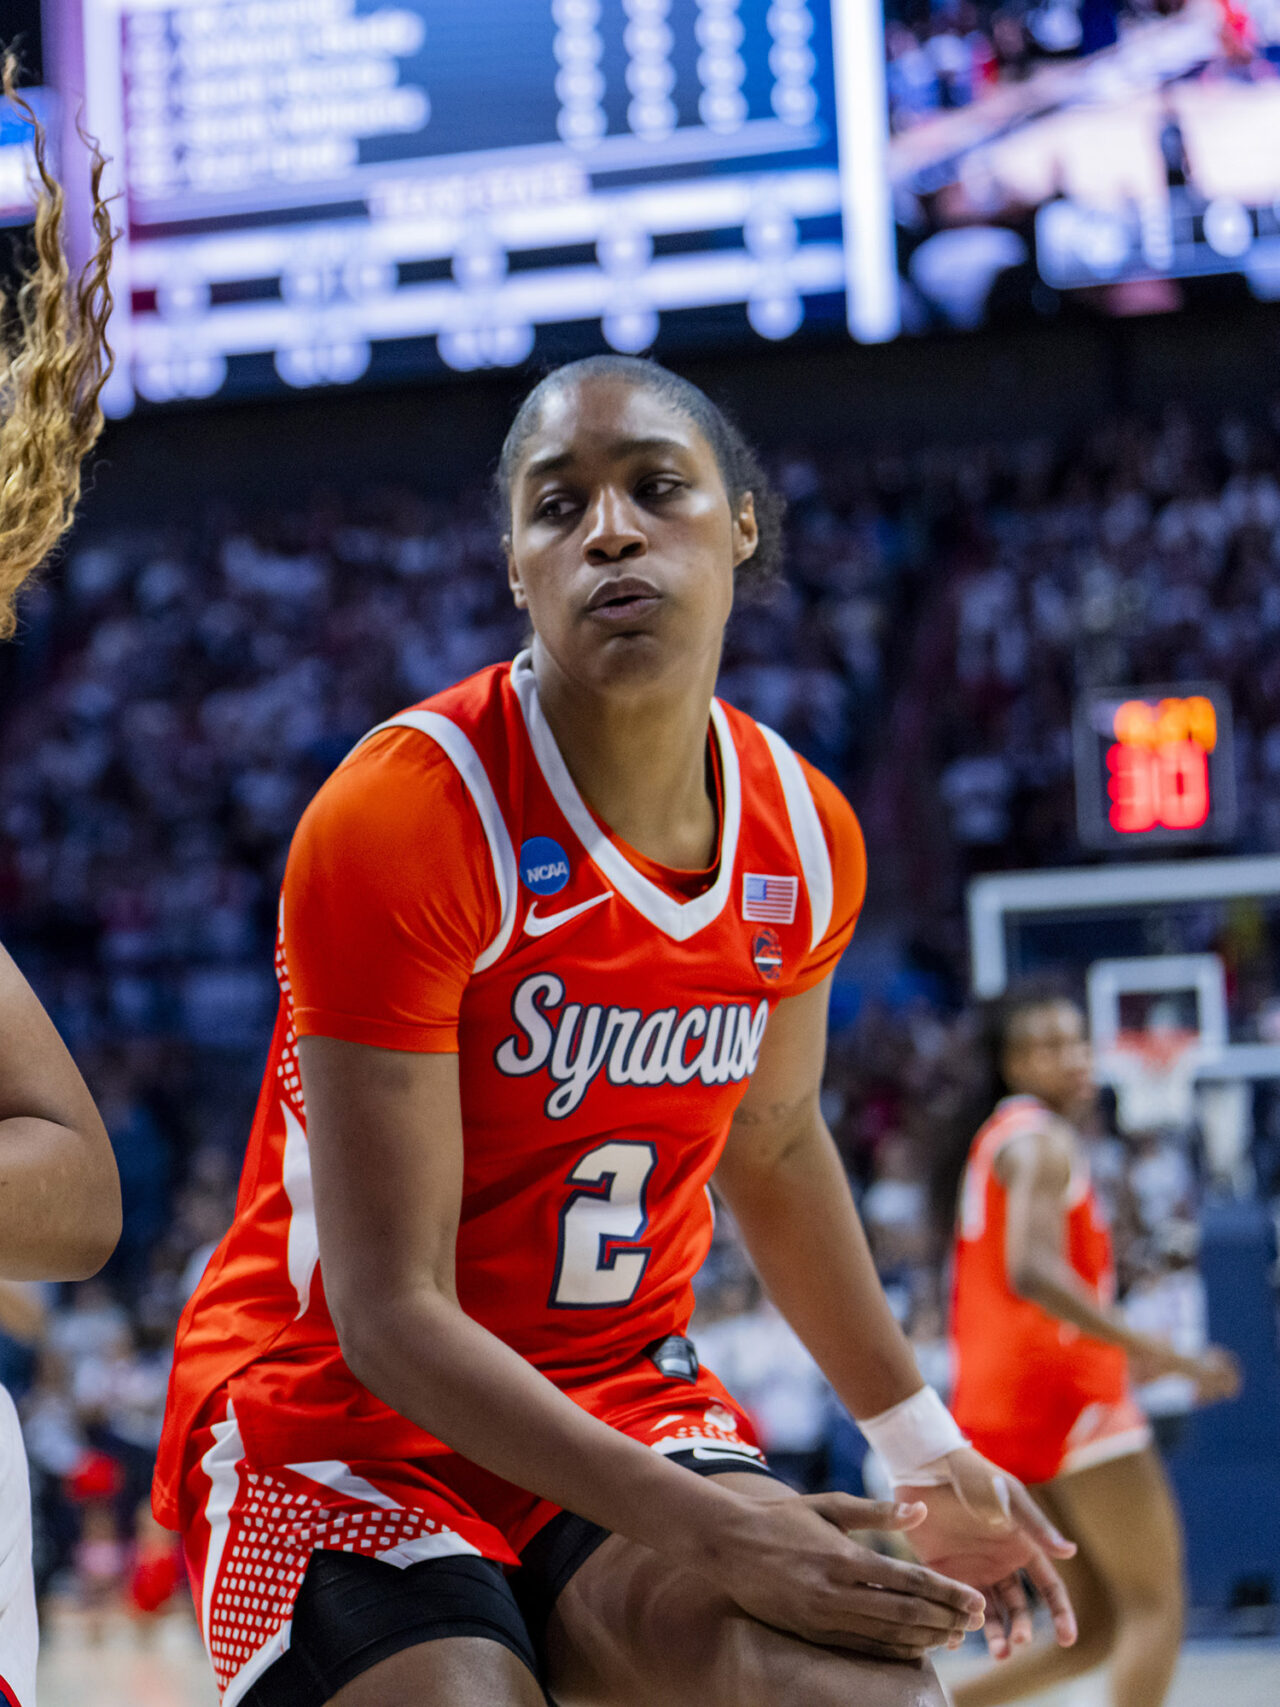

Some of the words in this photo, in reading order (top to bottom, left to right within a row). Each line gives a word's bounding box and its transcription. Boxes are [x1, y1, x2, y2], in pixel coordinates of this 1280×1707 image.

[526, 860, 569, 884] NCAA
[493, 972, 769, 1120] Syracuse
[547, 1138, 658, 1310] 2
